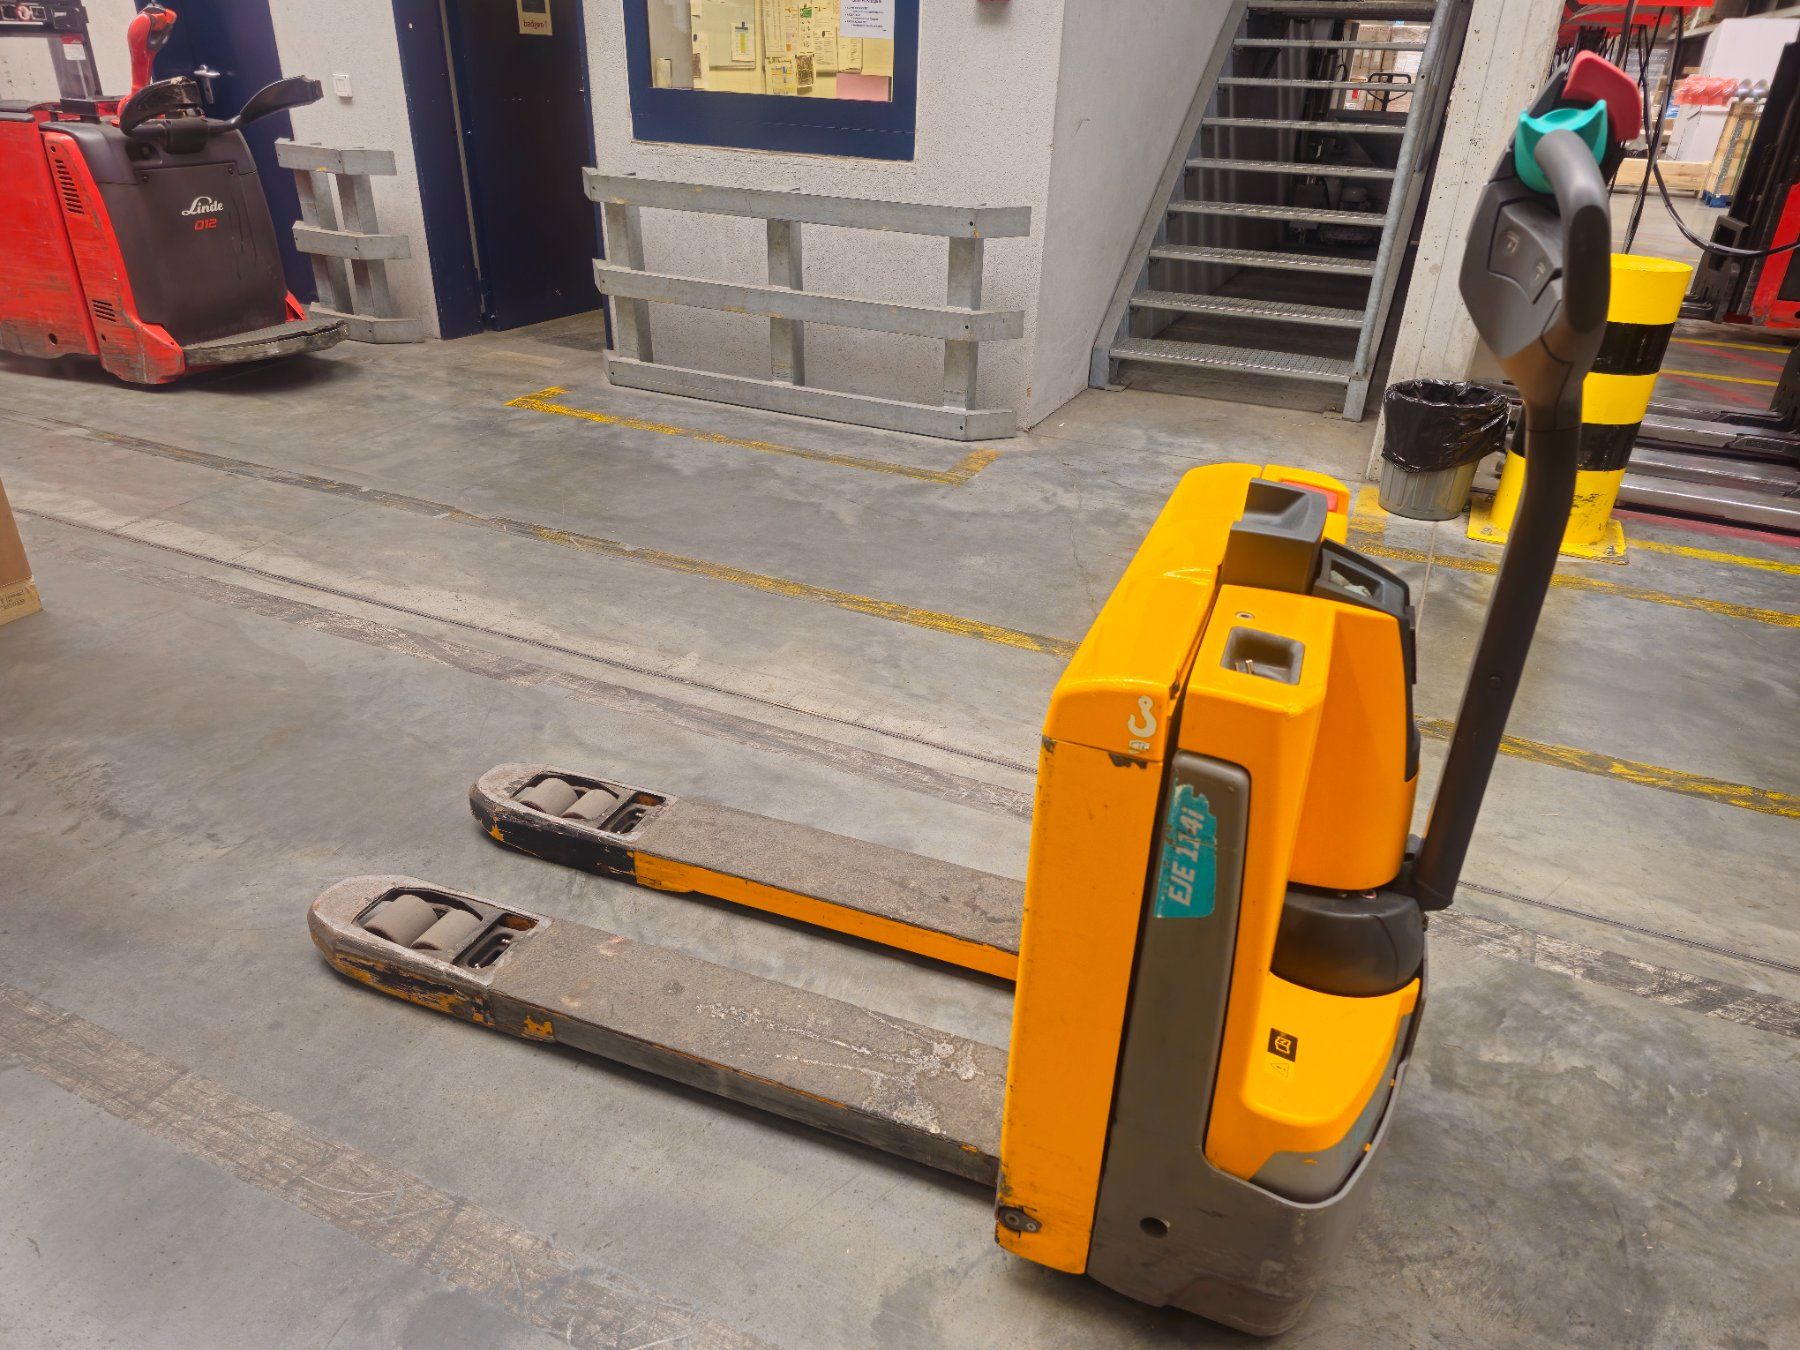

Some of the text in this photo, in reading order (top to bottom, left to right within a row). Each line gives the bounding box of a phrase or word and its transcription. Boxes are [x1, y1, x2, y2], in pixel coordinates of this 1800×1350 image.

[181, 196, 224, 216] Linde
[1168, 806, 1205, 907] EJE 114i
